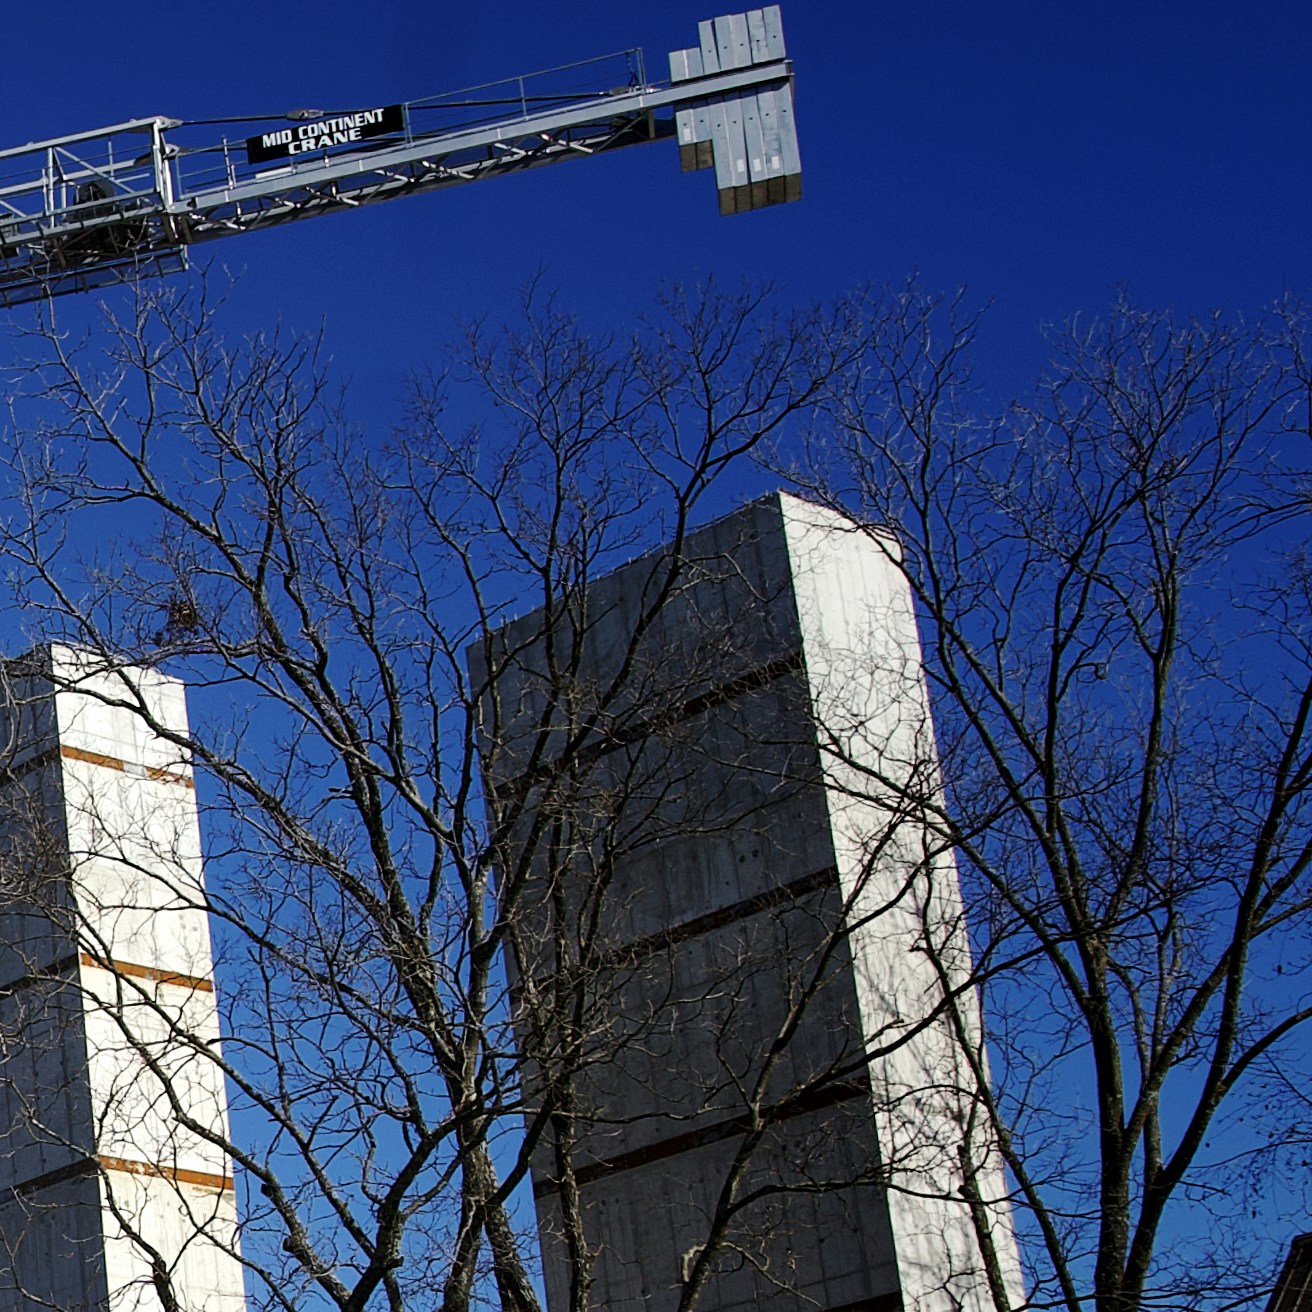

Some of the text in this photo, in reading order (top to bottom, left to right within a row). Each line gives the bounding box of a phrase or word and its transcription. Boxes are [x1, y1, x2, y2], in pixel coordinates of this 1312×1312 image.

[262, 108, 384, 149] MID CONTINENT
[288, 128, 362, 155] CRANE
